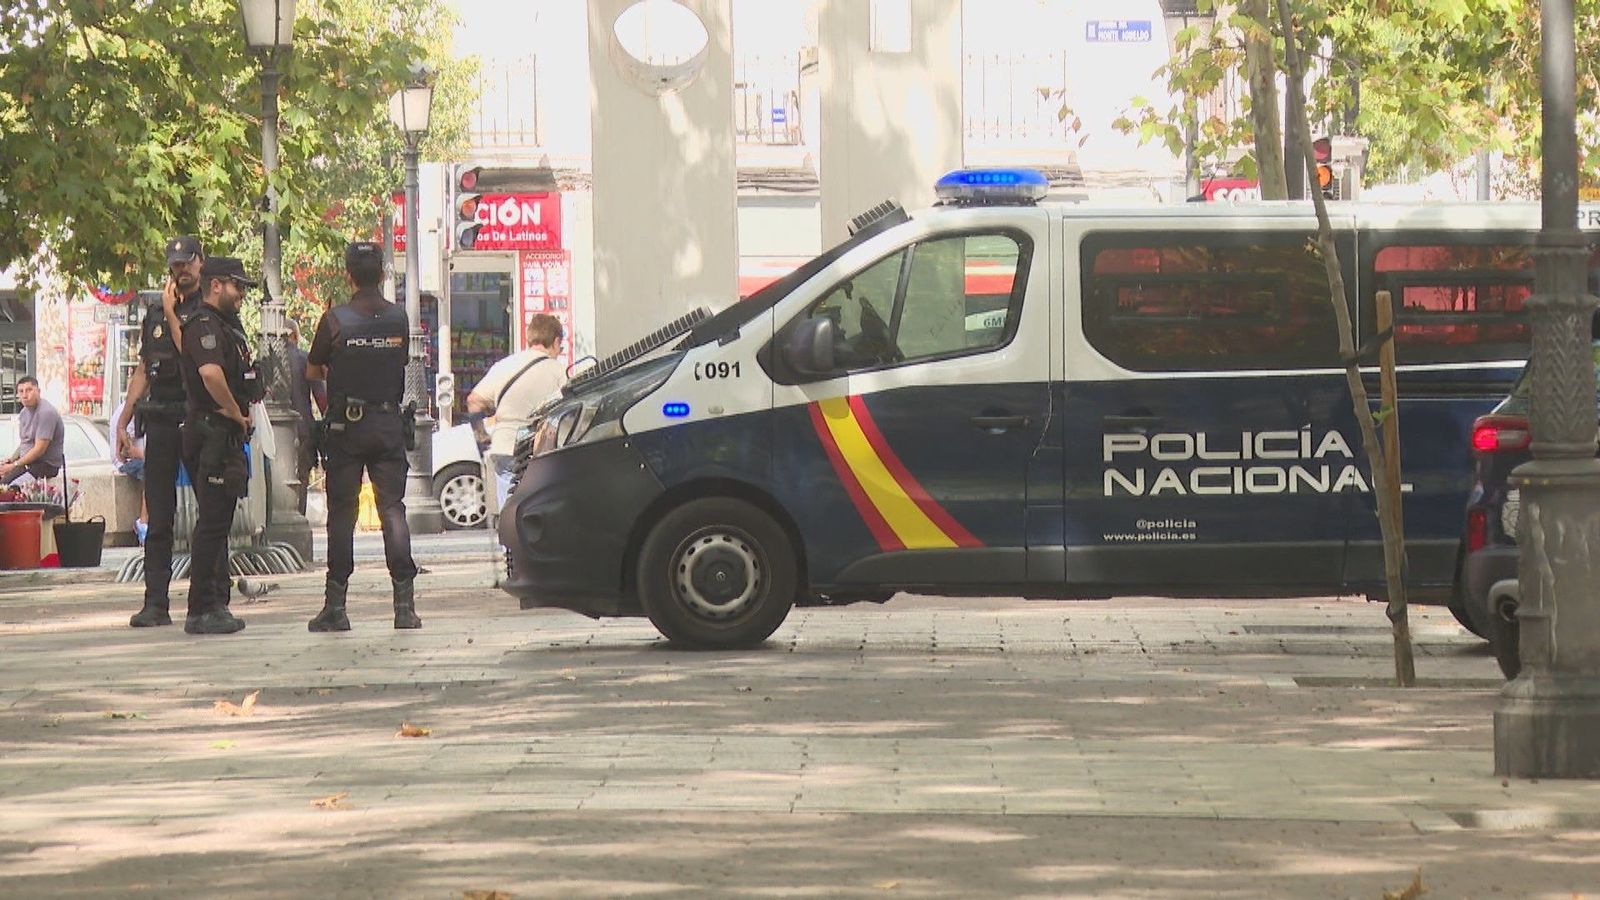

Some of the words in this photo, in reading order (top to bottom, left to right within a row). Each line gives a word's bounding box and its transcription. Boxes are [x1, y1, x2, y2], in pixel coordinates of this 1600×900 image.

[474, 196, 541, 227] CIÓN
[477, 232, 490, 241] os
[492, 231, 506, 241] De
[509, 231, 548, 241] Latinos
[705, 361, 741, 379] 091
[1103, 423, 1354, 461] POLICÍA
[1136, 518, 1197, 530] @policia
[1103, 531, 1197, 542] www.policia.es
